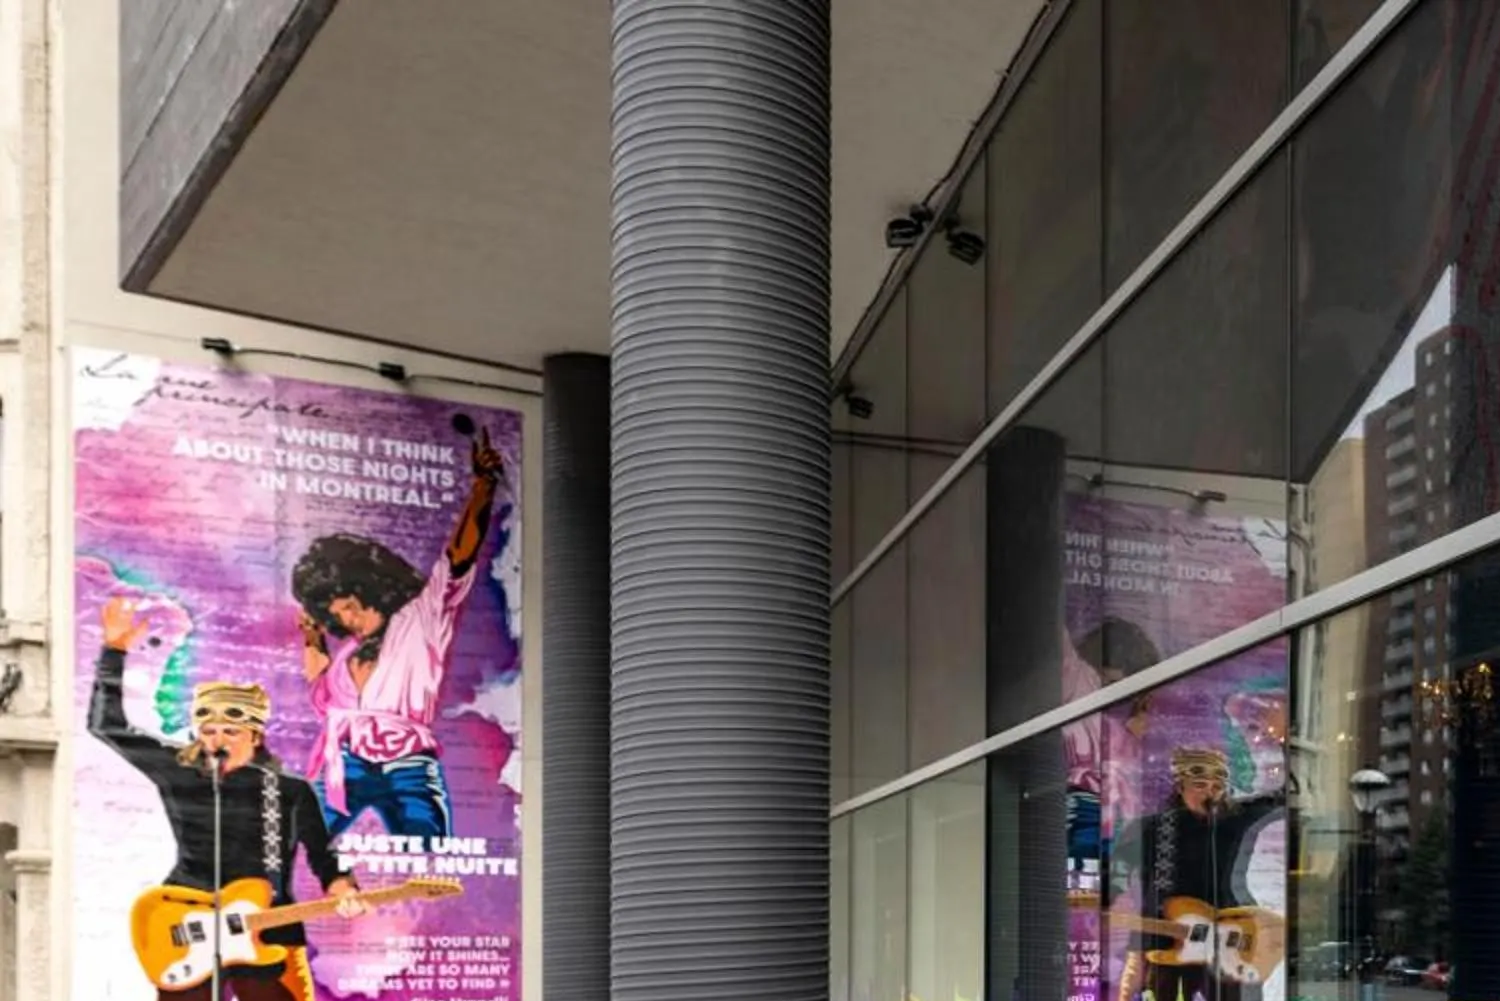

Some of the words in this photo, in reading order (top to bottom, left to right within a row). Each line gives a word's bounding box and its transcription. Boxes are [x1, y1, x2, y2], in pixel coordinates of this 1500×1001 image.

[367, 436, 375, 455] I
[380, 438, 455, 465] THINK
[173, 434, 262, 465] ABOUT
[274, 448, 356, 476] THOSE
[362, 458, 455, 488] NIGHTS
[258, 469, 288, 490] IN
[337, 833, 425, 853] JUSTE
[430, 836, 487, 855] UNE
[435, 856, 518, 876] NUITE
[429, 935, 473, 949] YOUR
[474, 935, 512, 949] STAR
[429, 950, 444, 962] IT
[405, 963, 435, 976] ARE
[438, 963, 461, 976] SO
[463, 963, 512, 977] MANY
[407, 977, 434, 990] YET
[437, 977, 460, 990] TO
[461, 977, 497, 990] FIND
